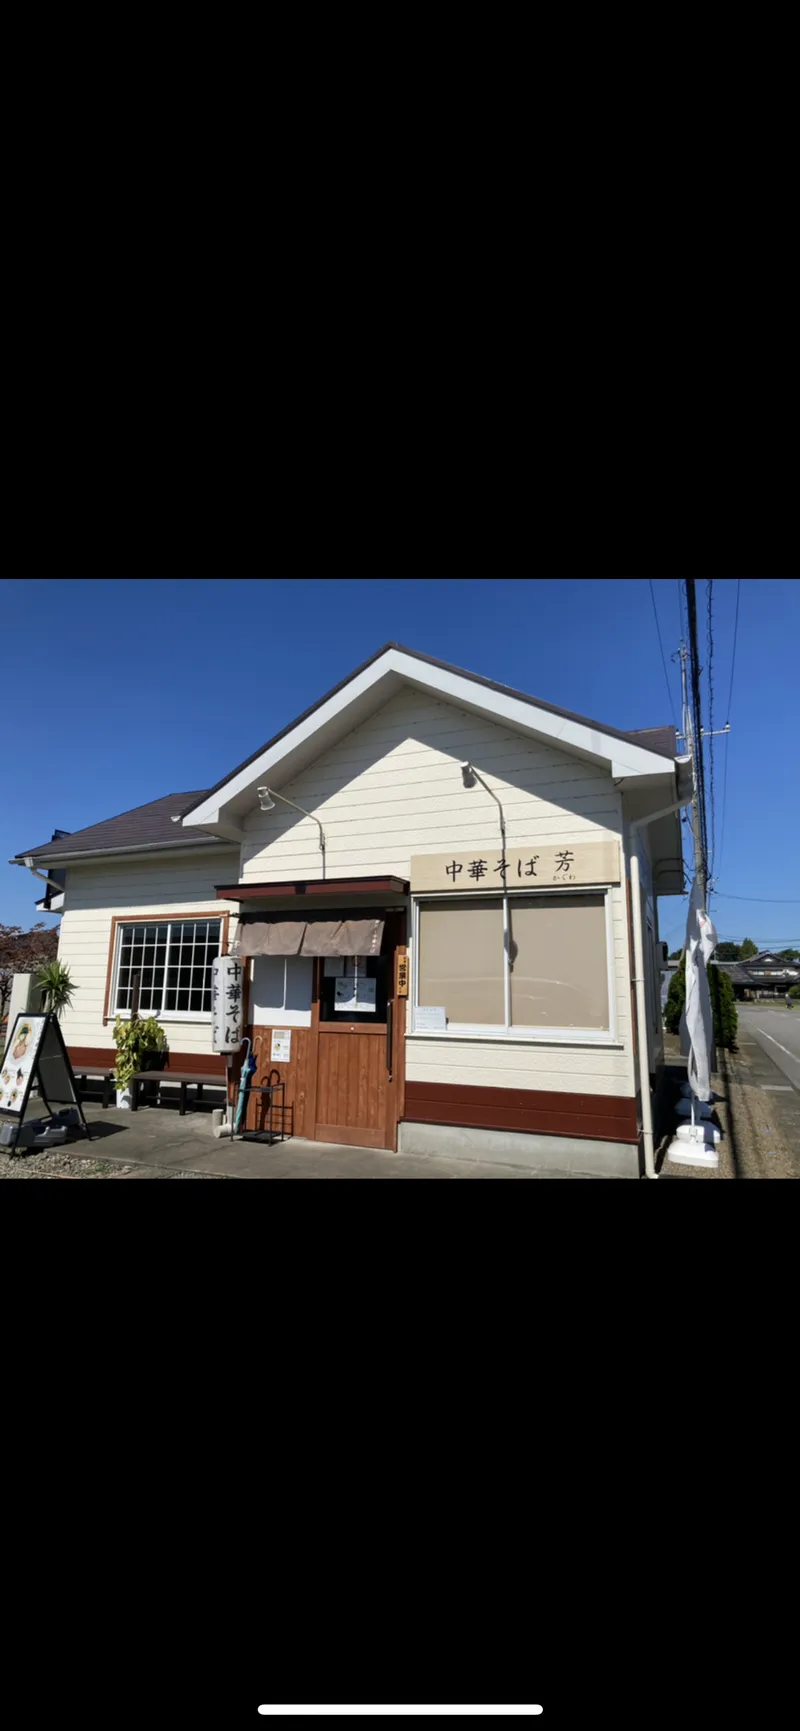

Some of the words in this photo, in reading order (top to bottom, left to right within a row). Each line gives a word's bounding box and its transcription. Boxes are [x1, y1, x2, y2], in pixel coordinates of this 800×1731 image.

[445, 855, 540, 883] 中華そば
[554, 850, 575, 872] 芳
[225, 963, 242, 1044] 中華そば
